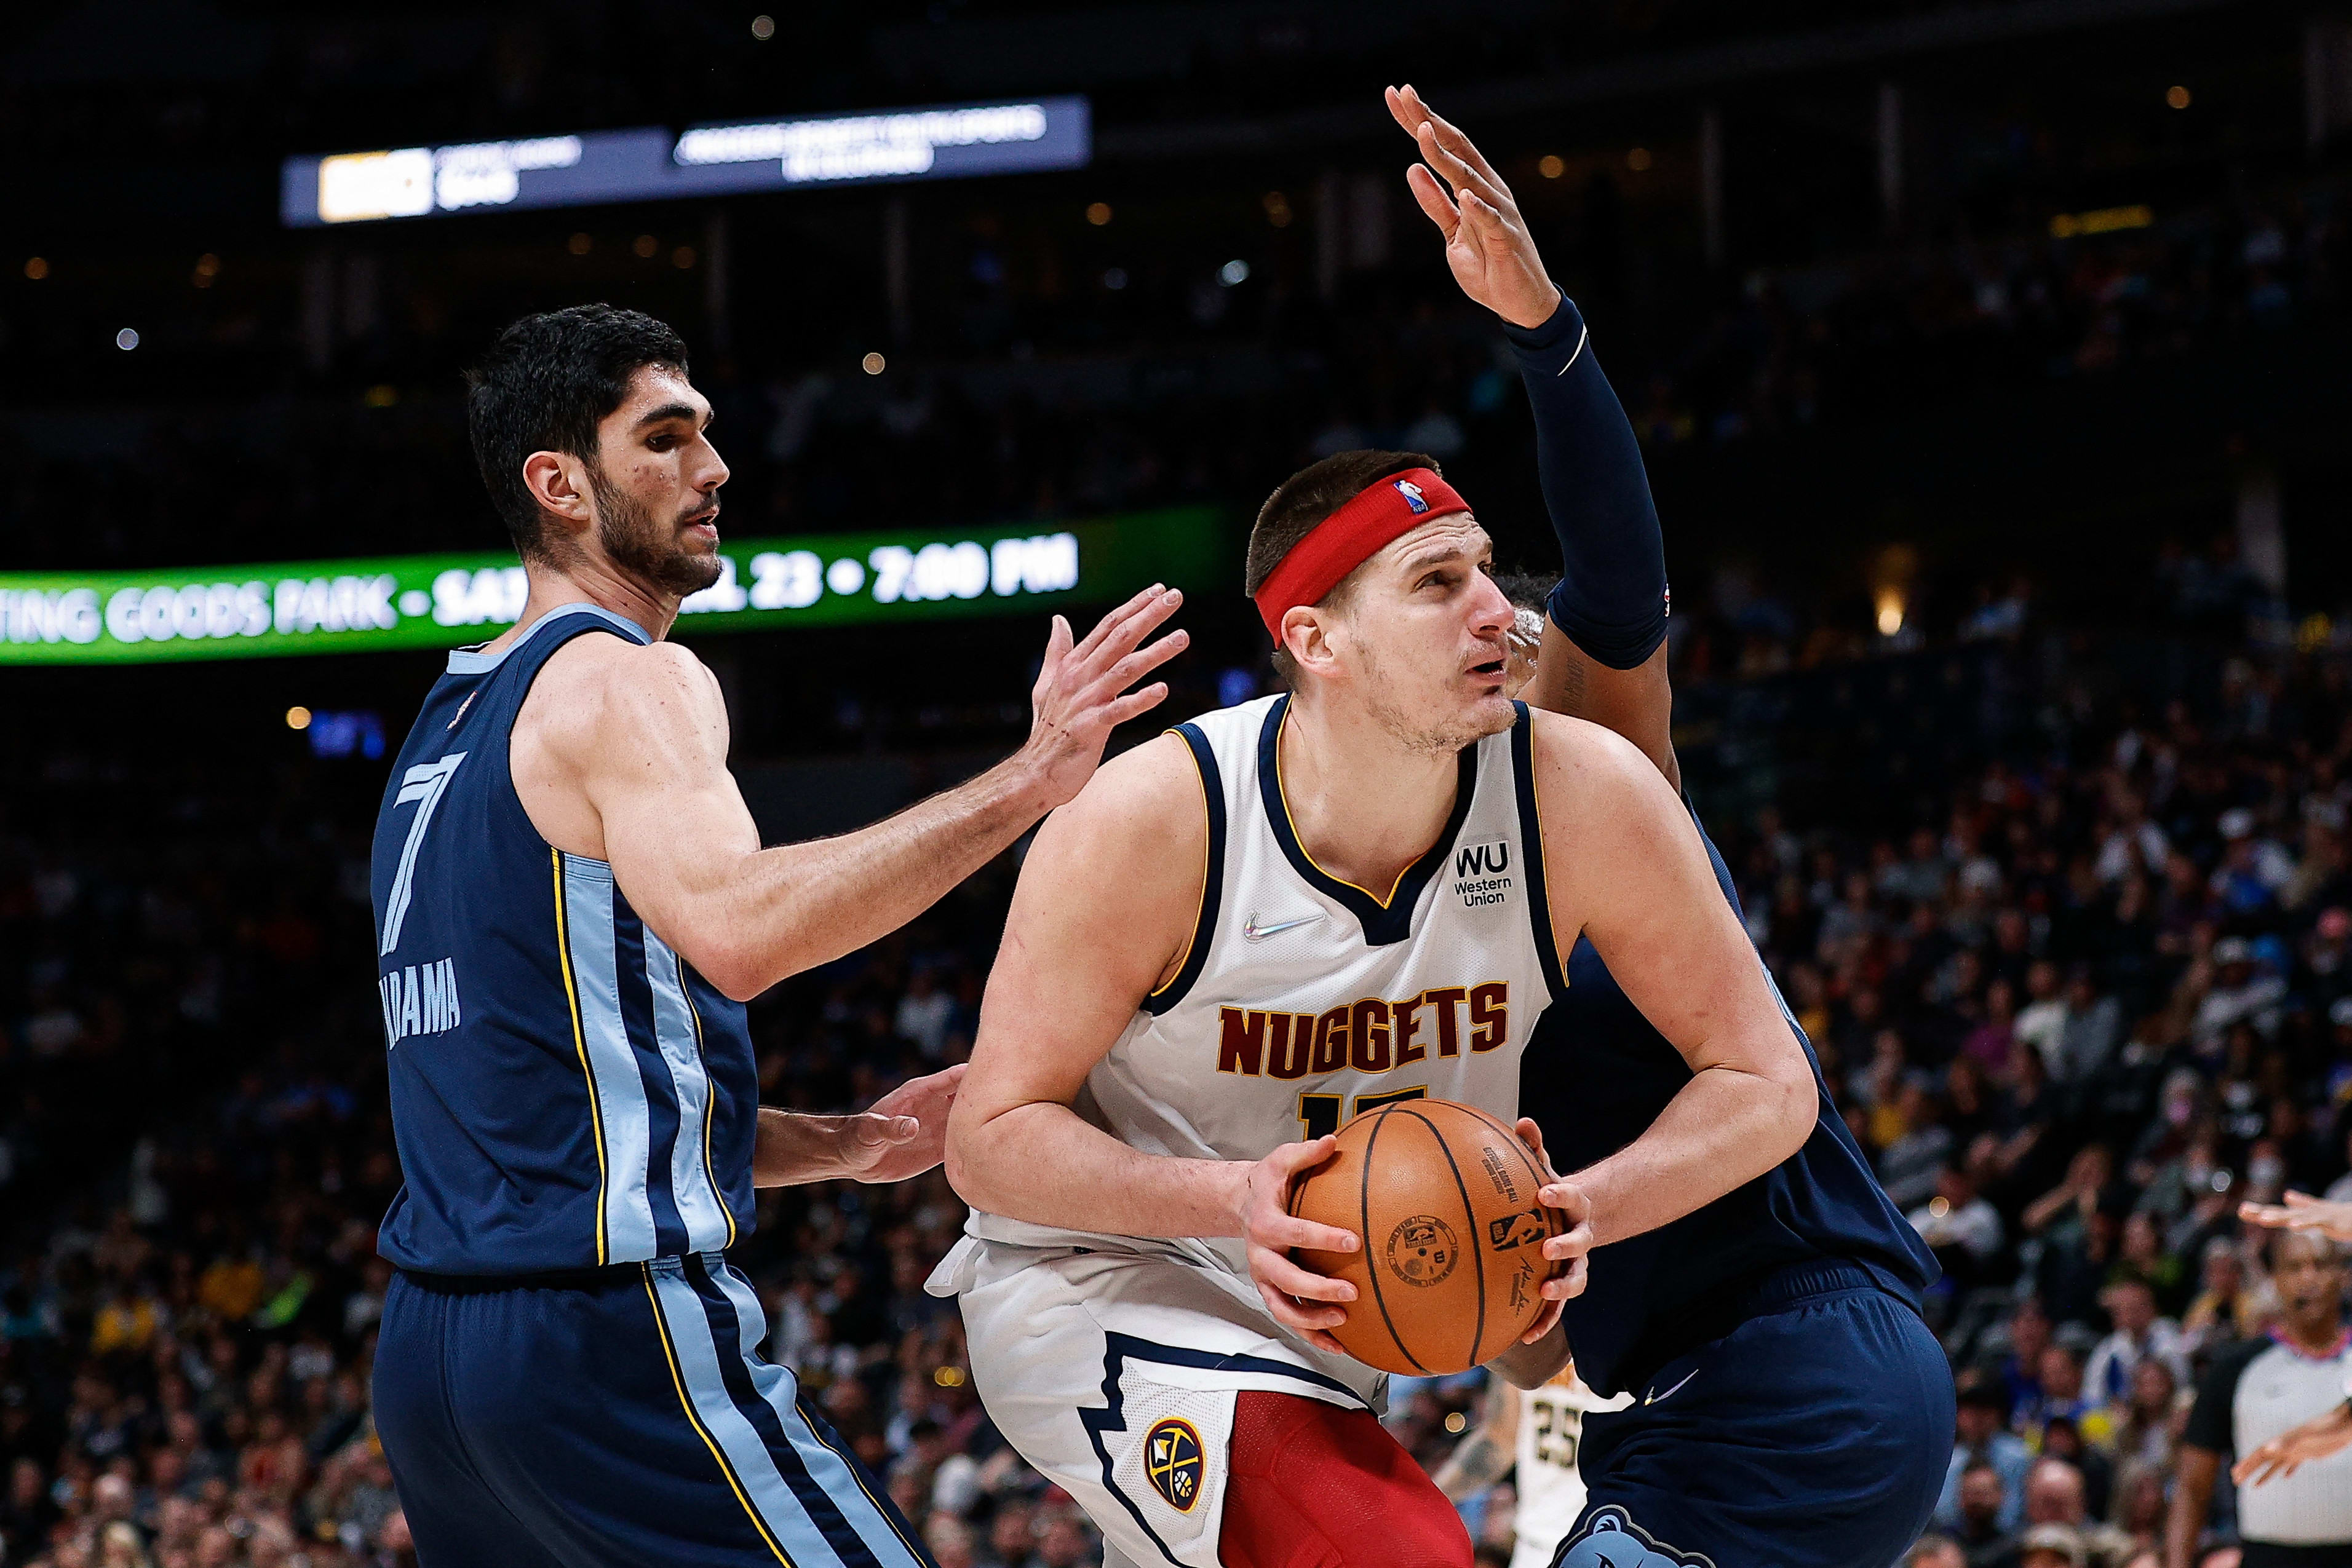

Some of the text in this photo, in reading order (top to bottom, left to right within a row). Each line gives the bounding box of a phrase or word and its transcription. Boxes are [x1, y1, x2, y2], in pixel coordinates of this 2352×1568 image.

[105, 581, 271, 643] GOODS
[274, 574, 399, 635] PARK
[749, 550, 823, 609] 23
[868, 541, 988, 603] 7:00
[991, 532, 1078, 596] PM
[380, 751, 468, 957] 7
[1455, 877, 1512, 895] Western
[1456, 842, 1508, 878] WU
[1464, 892, 1504, 907] Union
[1216, 980, 1509, 1080] NUGGETS
